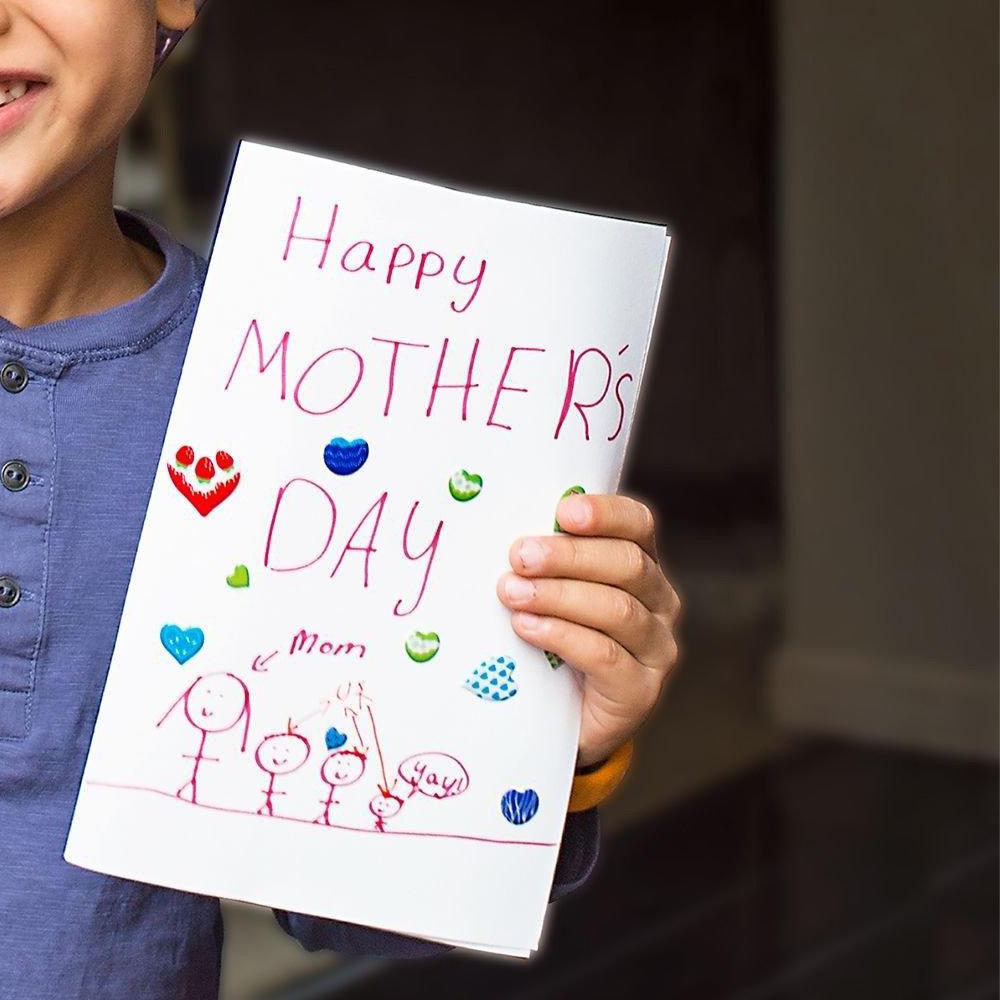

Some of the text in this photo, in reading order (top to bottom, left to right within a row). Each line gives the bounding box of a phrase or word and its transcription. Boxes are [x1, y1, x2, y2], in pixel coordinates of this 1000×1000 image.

[282, 195, 487, 313] Happy
[263, 477, 445, 617] DAY
[288, 628, 367, 659] Mom
